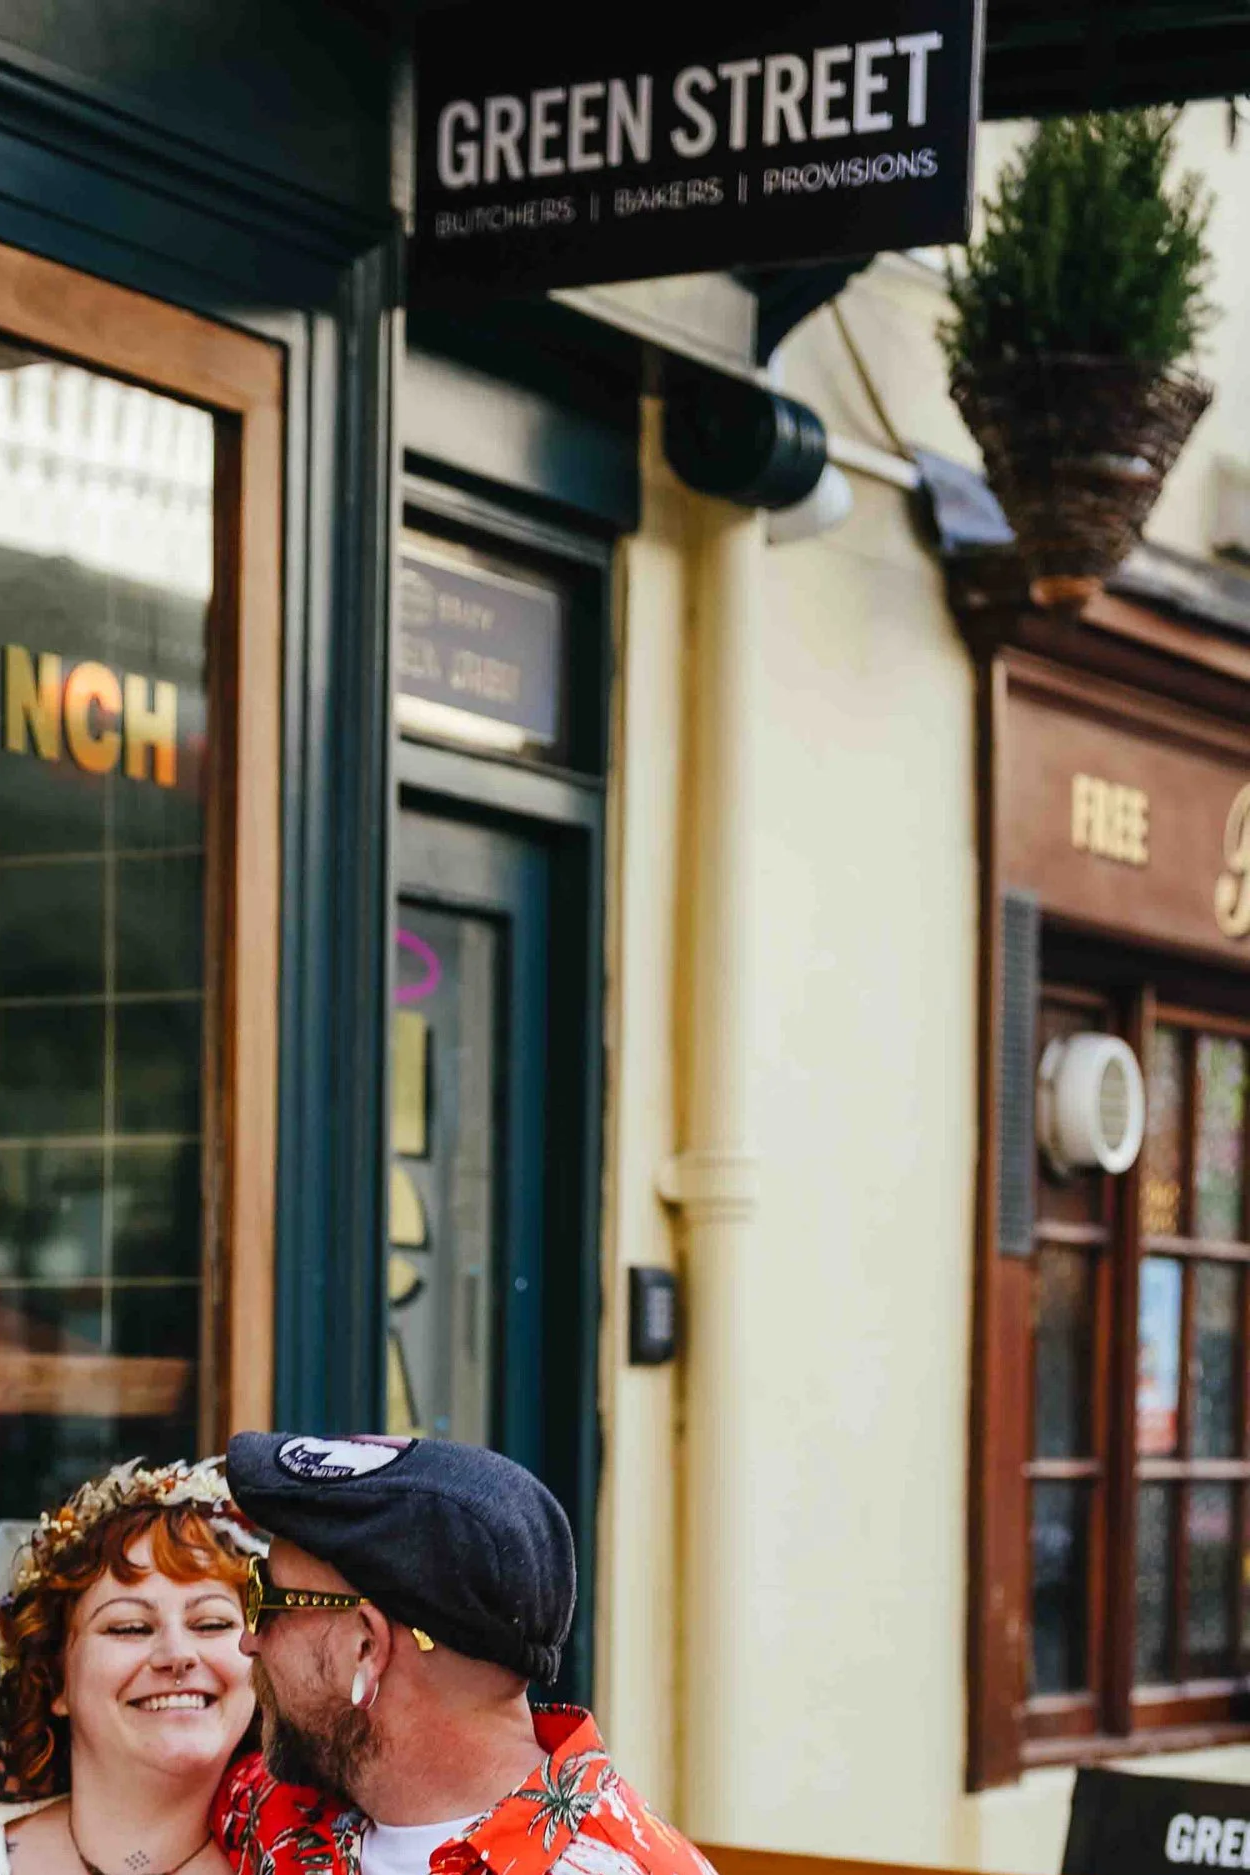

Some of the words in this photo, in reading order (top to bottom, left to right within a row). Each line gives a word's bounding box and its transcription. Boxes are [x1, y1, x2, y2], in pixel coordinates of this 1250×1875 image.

[437, 75, 652, 189] GREEN
[670, 31, 943, 158] STREET
[435, 196, 577, 239] BUTCHERS
[613, 178, 725, 217] BAKERS
[763, 147, 939, 196] PROVISIONS
[1071, 772, 1149, 866] FREE
[1164, 1812, 1250, 1870] GRE
